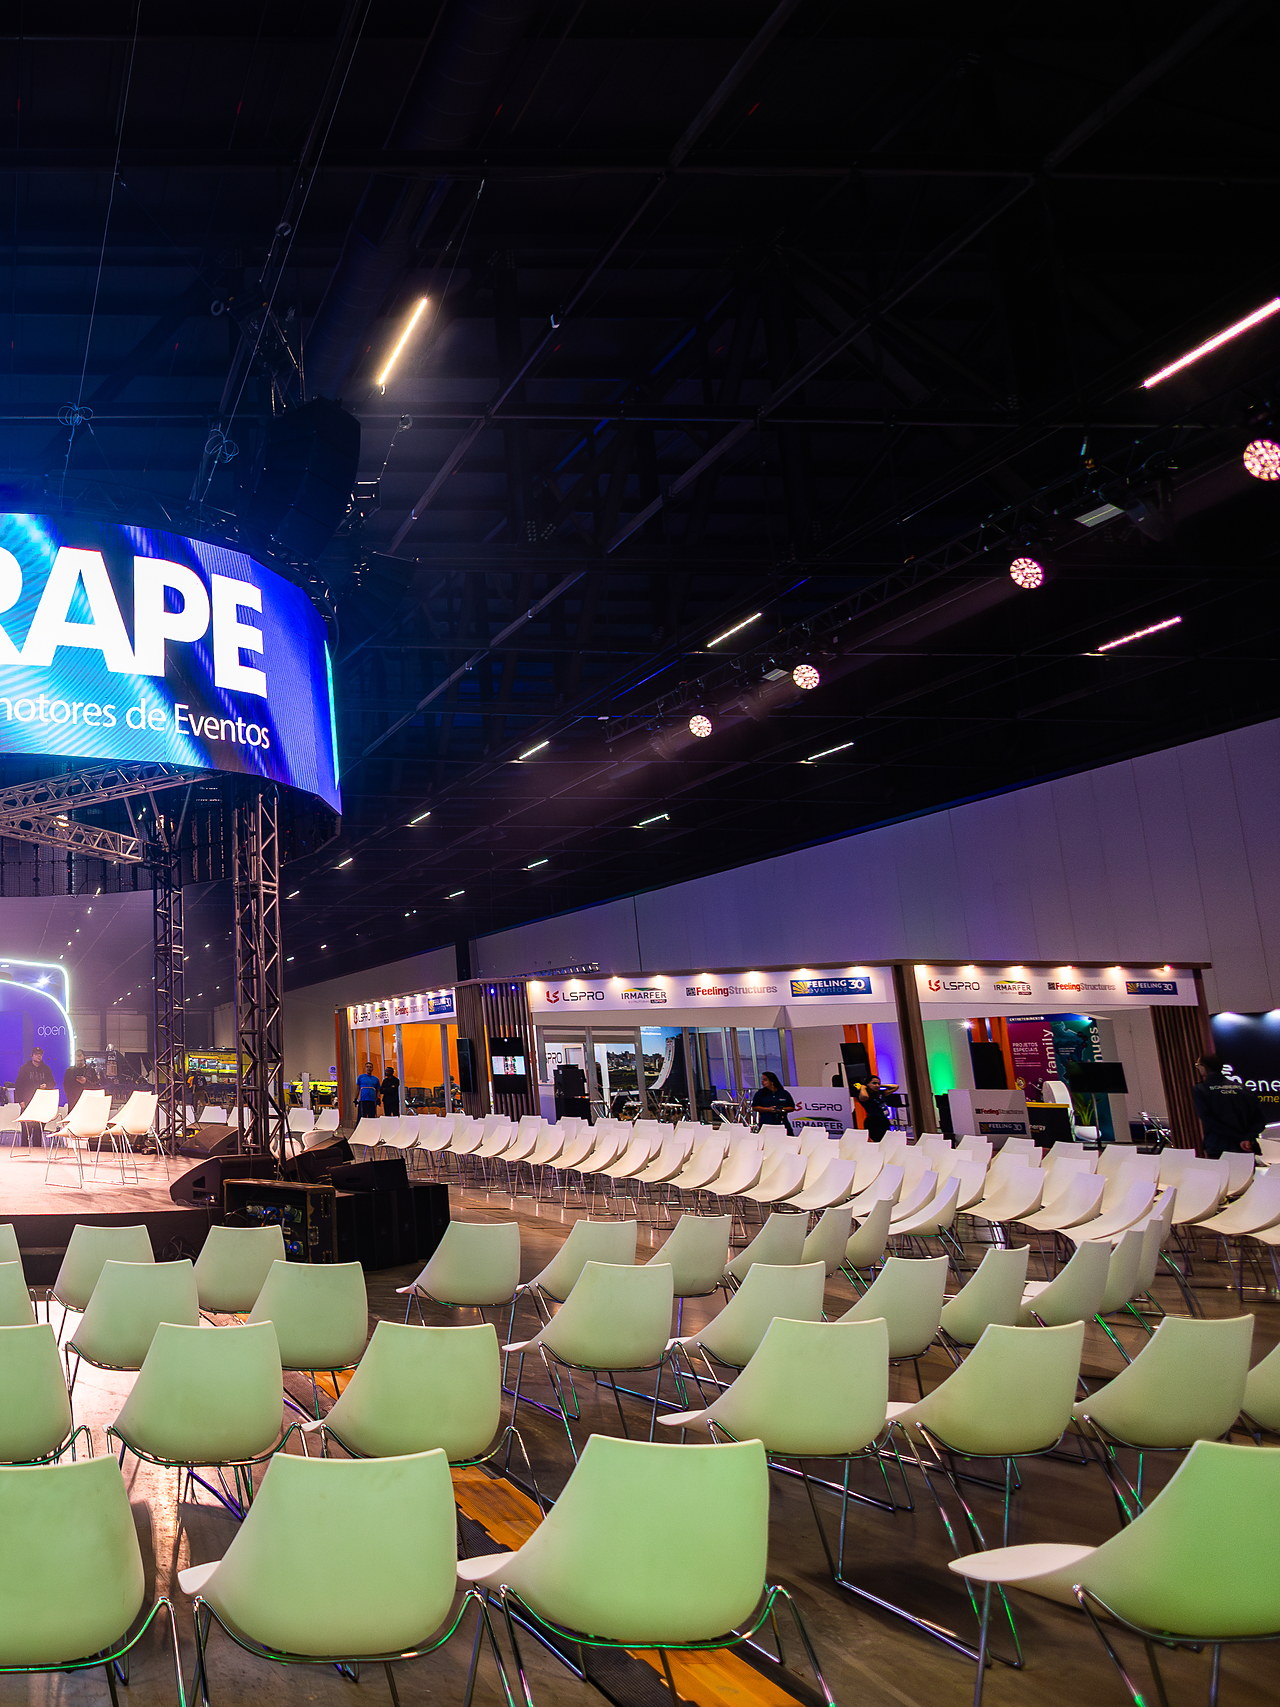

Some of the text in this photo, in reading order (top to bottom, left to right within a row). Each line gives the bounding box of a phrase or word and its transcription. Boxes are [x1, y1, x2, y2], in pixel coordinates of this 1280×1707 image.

[126, 698, 166, 731] de
[175, 702, 270, 749] Eventos
[807, 979, 867, 990] FEELING 30
[943, 981, 980, 991] LSPRO
[993, 984, 1032, 992] IRMARFER
[1162, 983, 1174, 991] 30
[562, 991, 605, 1002] LSPRO
[621, 991, 667, 1000] IRMARFER
[1089, 1026, 1104, 1063] nues
[1041, 1028, 1058, 1074] family
[545, 1052, 563, 1064] PRO
[804, 1103, 843, 1112] LSPRO
[792, 1120, 844, 1130] IRMARFER
